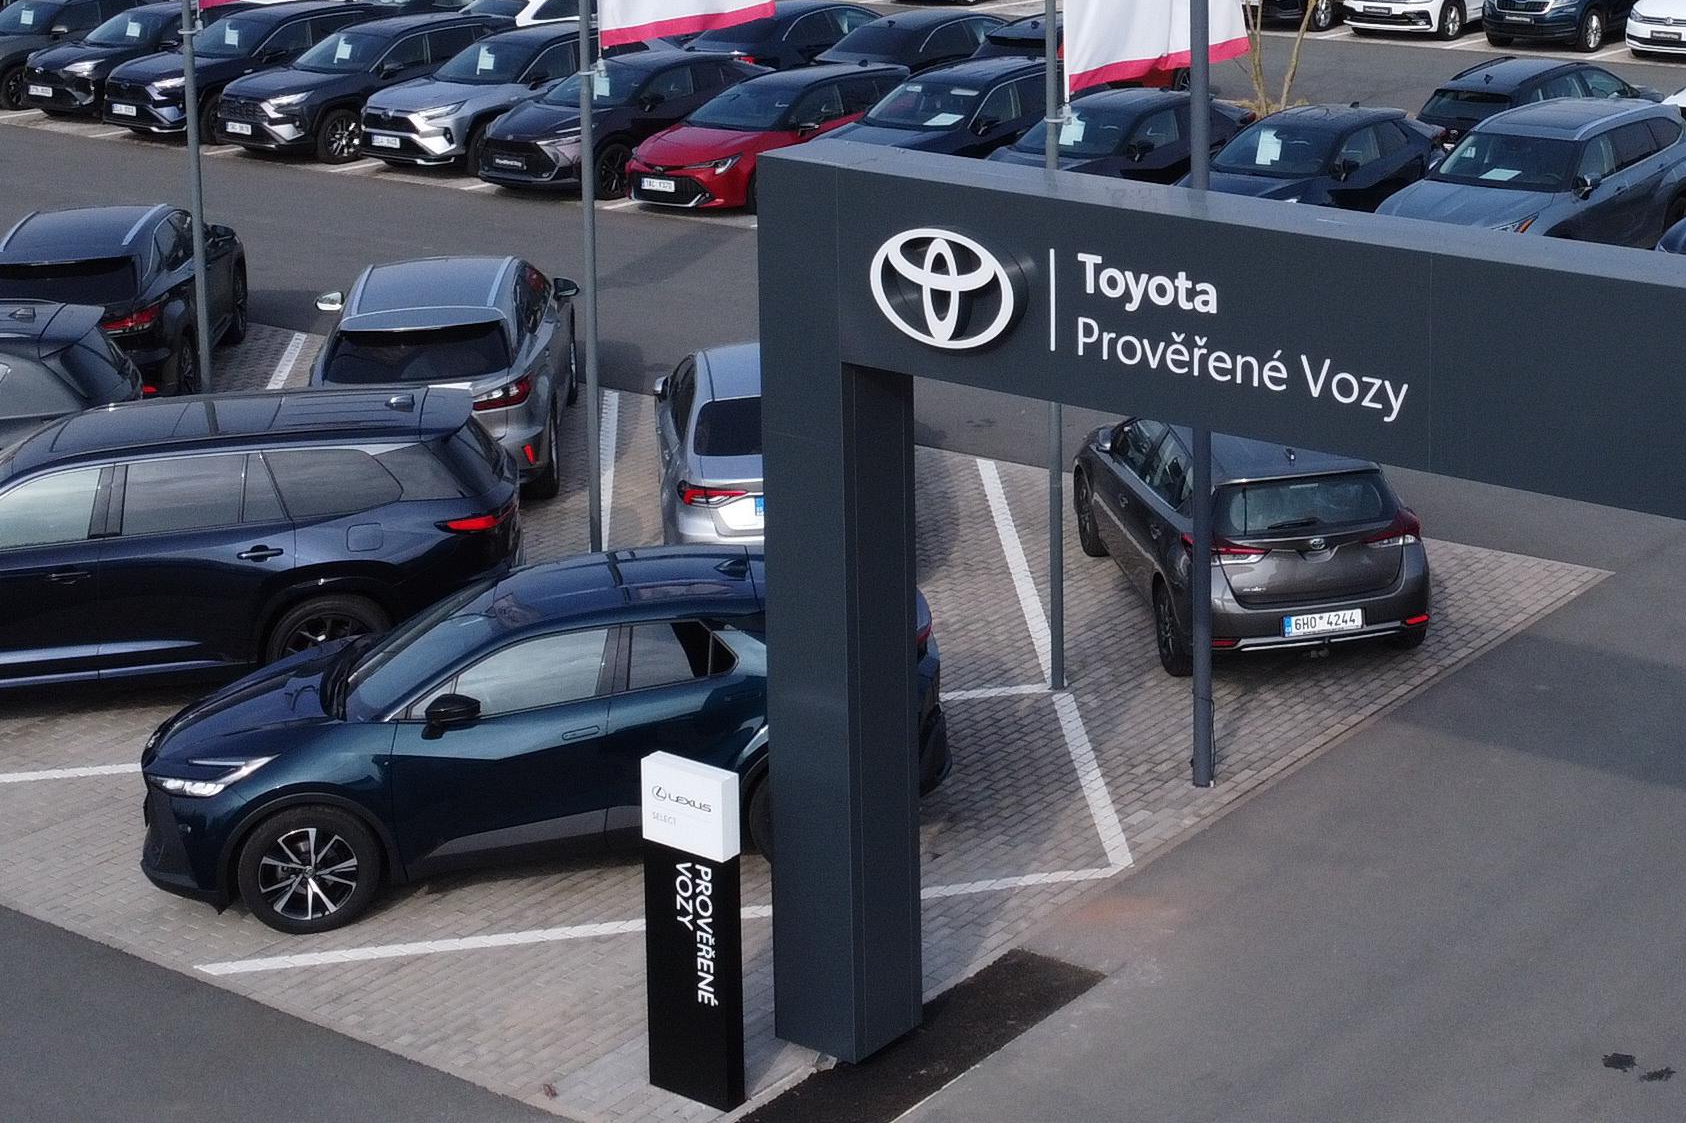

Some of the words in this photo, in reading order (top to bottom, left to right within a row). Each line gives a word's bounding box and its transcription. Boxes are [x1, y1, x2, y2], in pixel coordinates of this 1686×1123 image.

[1077, 252, 1218, 314] Toyota
[1077, 316, 1288, 392] Prověřené
[1301, 353, 1409, 423] Vozy
[1326, 612, 1356, 627] 4244
[652, 811, 677, 827] SELECT
[668, 792, 713, 813] LEXUS
[675, 861, 694, 932] VOZY
[694, 863, 719, 1008] PROVĚŘENÉ
